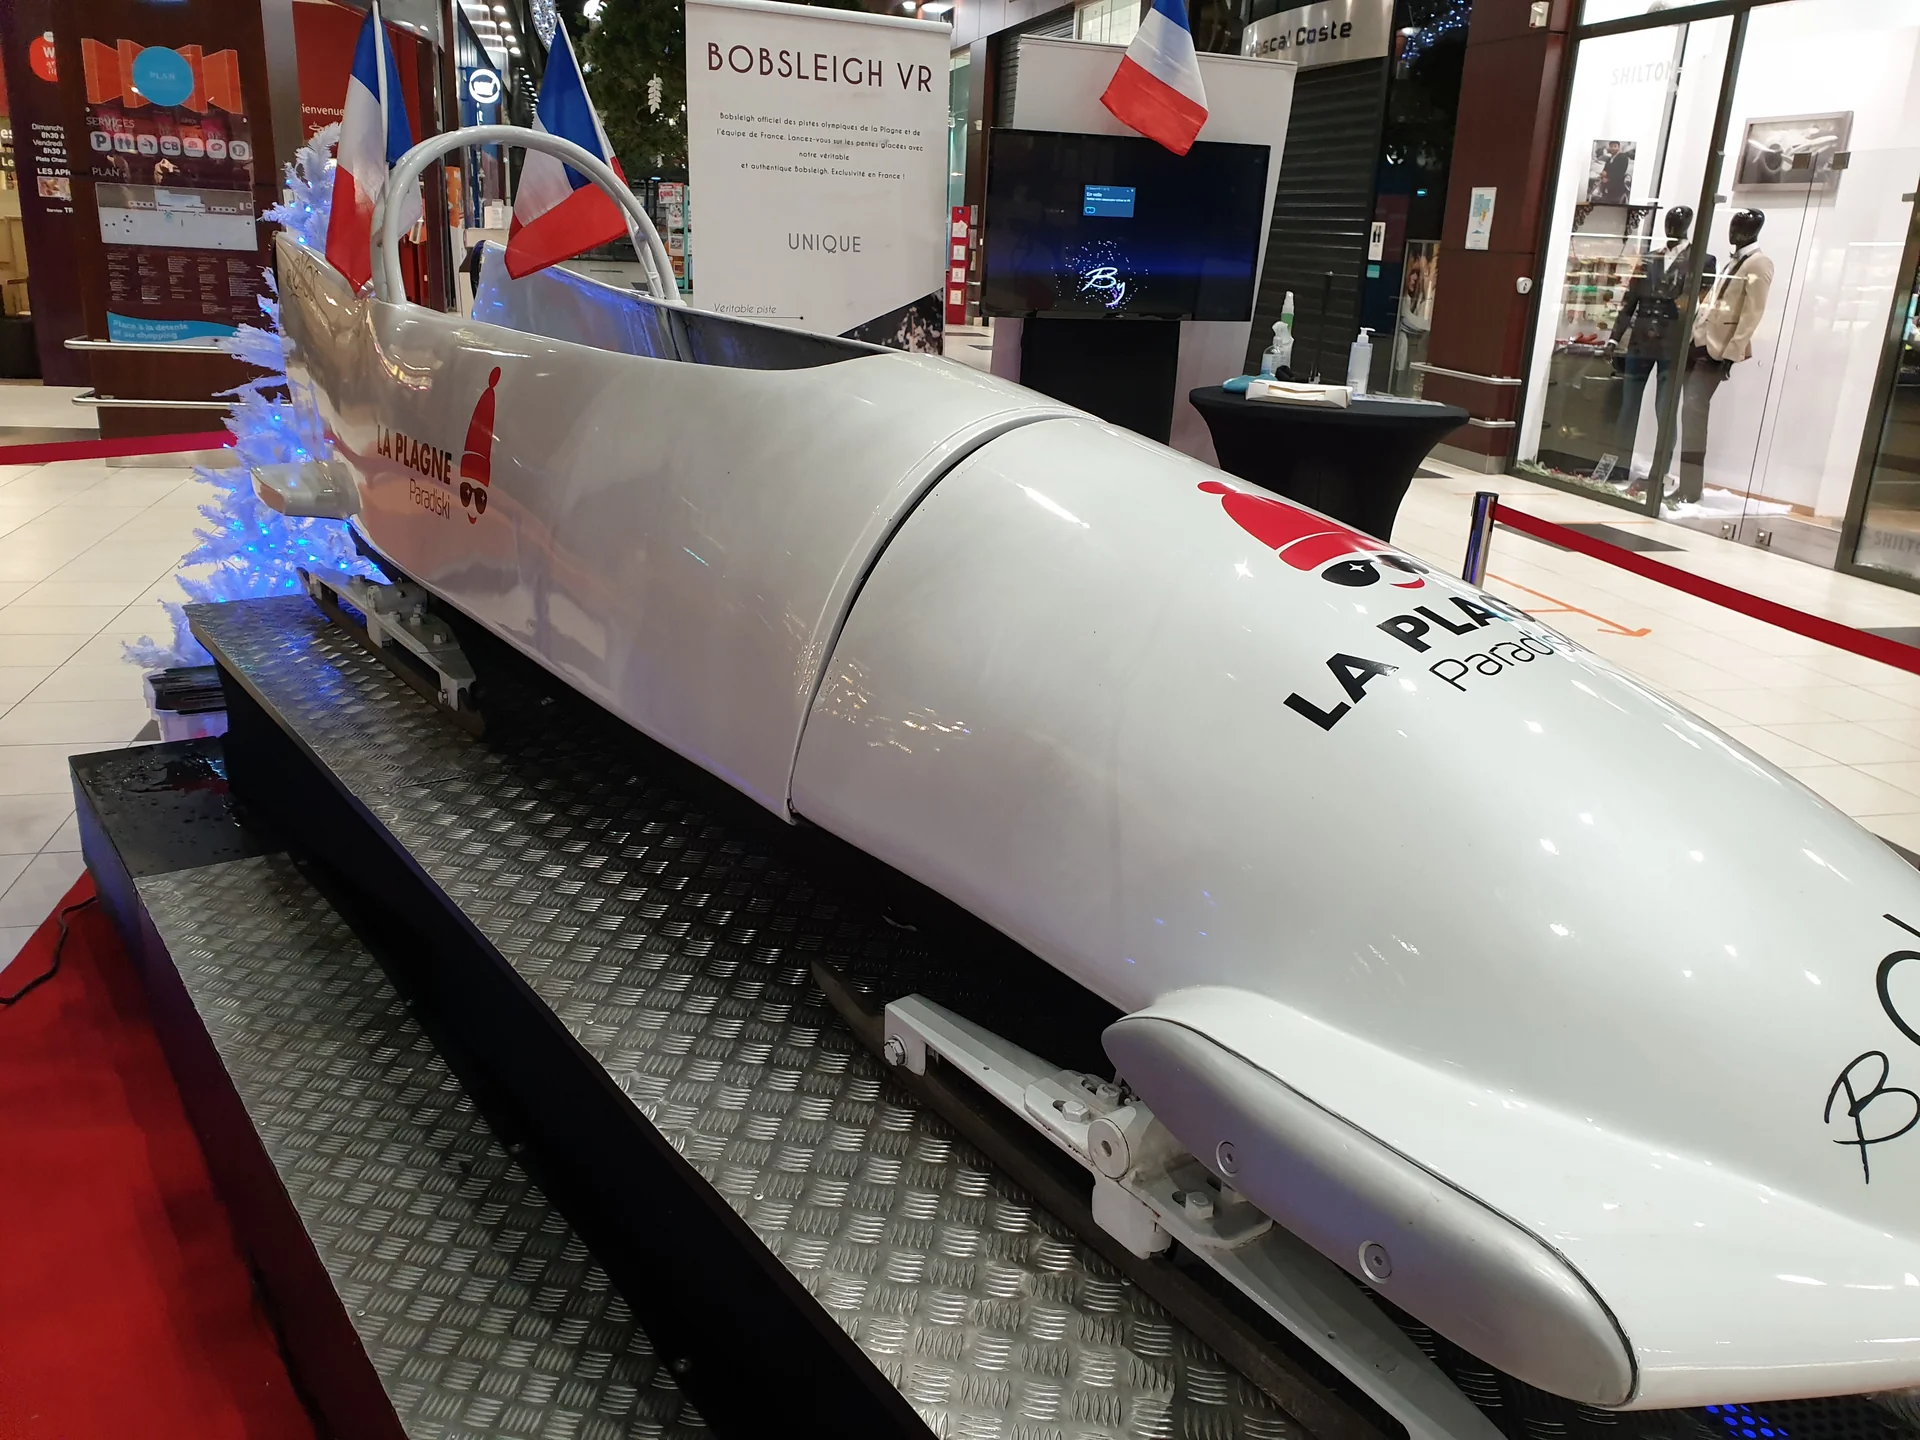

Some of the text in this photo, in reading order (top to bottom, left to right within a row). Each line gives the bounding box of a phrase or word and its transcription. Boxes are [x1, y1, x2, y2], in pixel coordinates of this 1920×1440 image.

[1296, 20, 1352, 46] Coste
[149, 71, 176, 81] PLAN
[707, 41, 932, 93] BOBSLEIGH VR
[31, 123, 64, 132] Dimanch
[86, 116, 135, 129] SERVICES
[719, 112, 756, 123] Bobsleigh
[757, 115, 782, 125] officiel
[783, 118, 797, 126] des
[820, 121, 858, 132] olympiques
[859, 124, 870, 132] de
[870, 125, 879, 133] la
[880, 126, 903, 135] Plagne
[912, 129, 922, 137] de
[162, 140, 179, 151] CB
[716, 128, 747, 138] l'équipe
[748, 130, 759, 138] de
[787, 133, 832, 145] Lancez-vous
[844, 138, 855, 146] les
[855, 140, 879, 148] pentes
[880, 141, 908, 150] glacées
[908, 144, 925, 152] avec
[819, 152, 850, 161] véritable
[92, 167, 120, 177] PLAN
[751, 163, 793, 172] authentique
[831, 168, 865, 178] Exclusivité
[878, 172, 901, 180] France
[788, 233, 861, 254] UNIQUE
[1081, 266, 1125, 306] By
[756, 305, 777, 314] piste
[113, 320, 136, 329] Place
[377, 424, 452, 486] LA PLAGNE
[409, 478, 451, 520] Paradiski
[1282, 652, 1400, 732] LA
